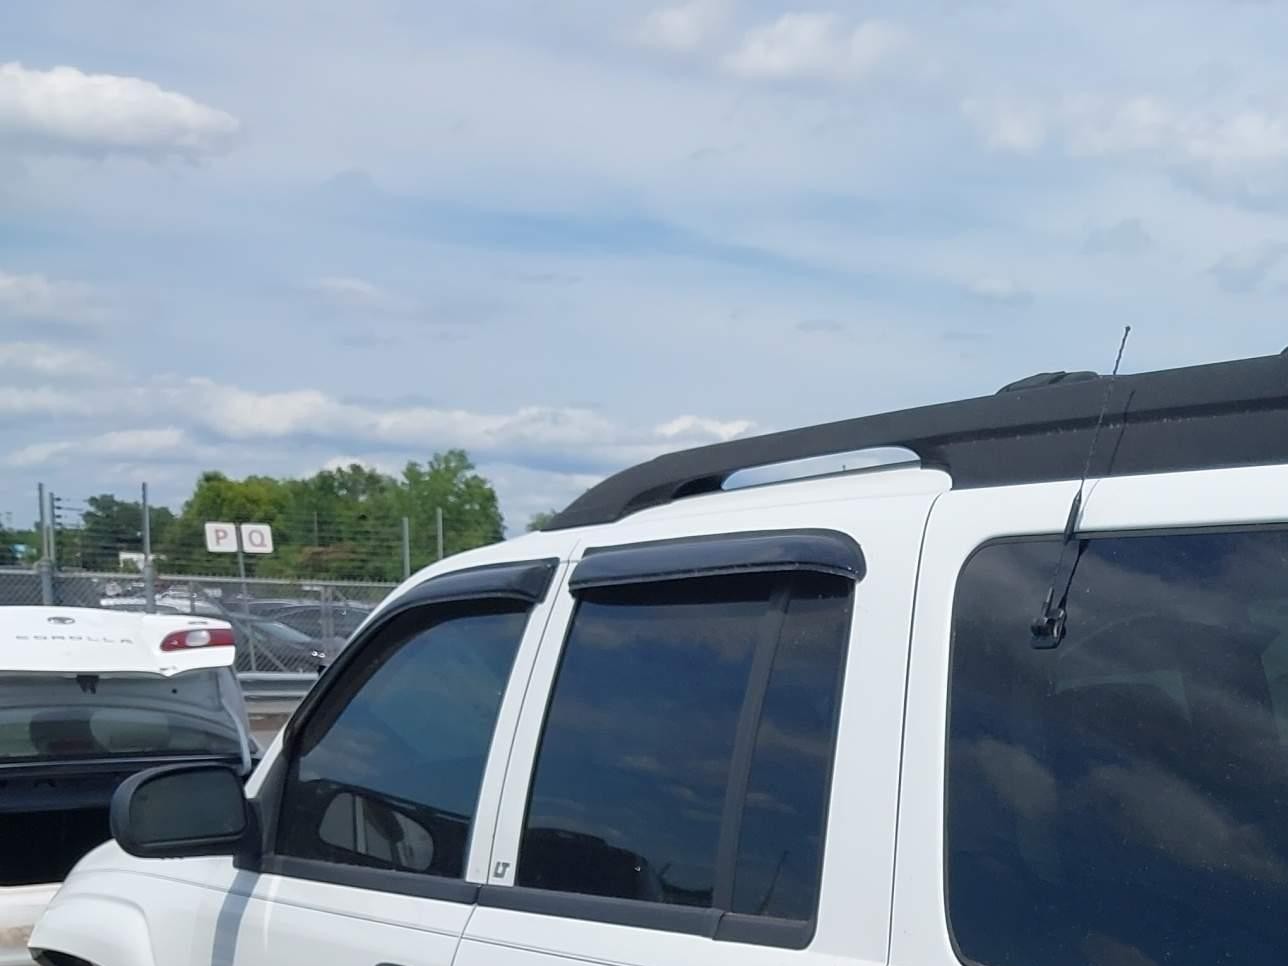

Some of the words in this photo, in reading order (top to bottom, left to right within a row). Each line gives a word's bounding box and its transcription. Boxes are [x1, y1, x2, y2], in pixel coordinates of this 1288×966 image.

[215, 529, 228, 546] P
[248, 529, 267, 548] Q
[15, 635, 134, 645] COROLLA
